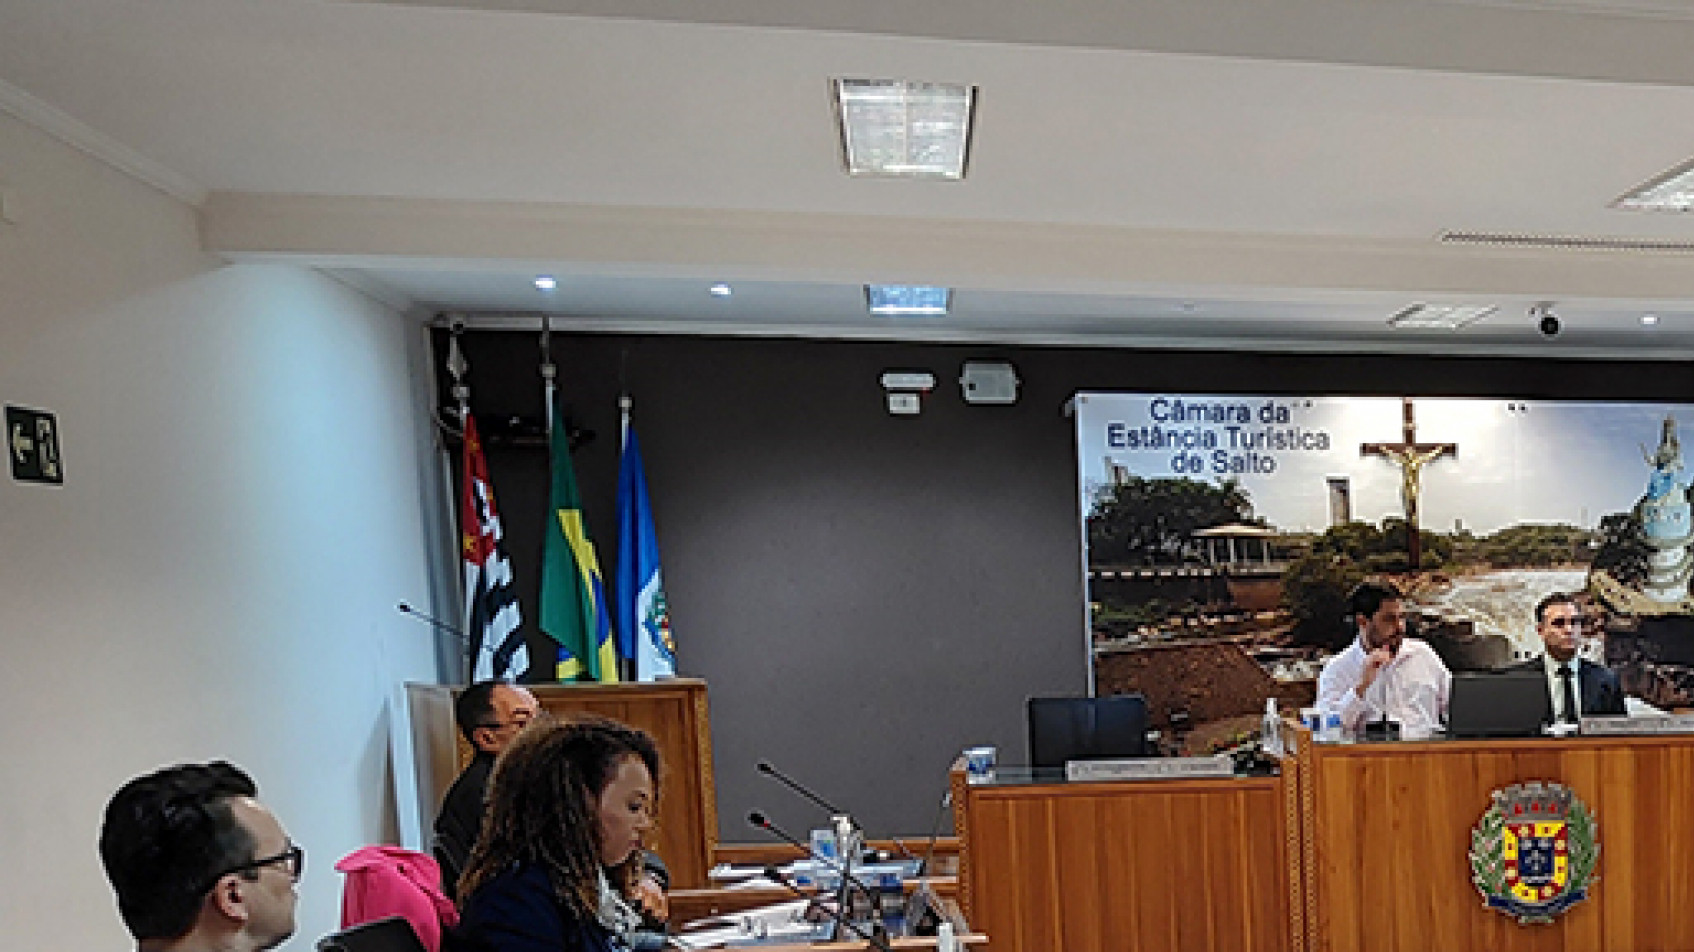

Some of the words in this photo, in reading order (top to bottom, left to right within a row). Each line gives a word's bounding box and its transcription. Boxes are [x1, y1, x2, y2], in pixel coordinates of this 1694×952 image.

[1150, 398, 1250, 423] Câmara
[1259, 400, 1291, 423] da
[1107, 422, 1218, 448] Estância
[1225, 425, 1330, 450] Turística
[1170, 450, 1204, 473] de
[1211, 450, 1277, 473] Salto
